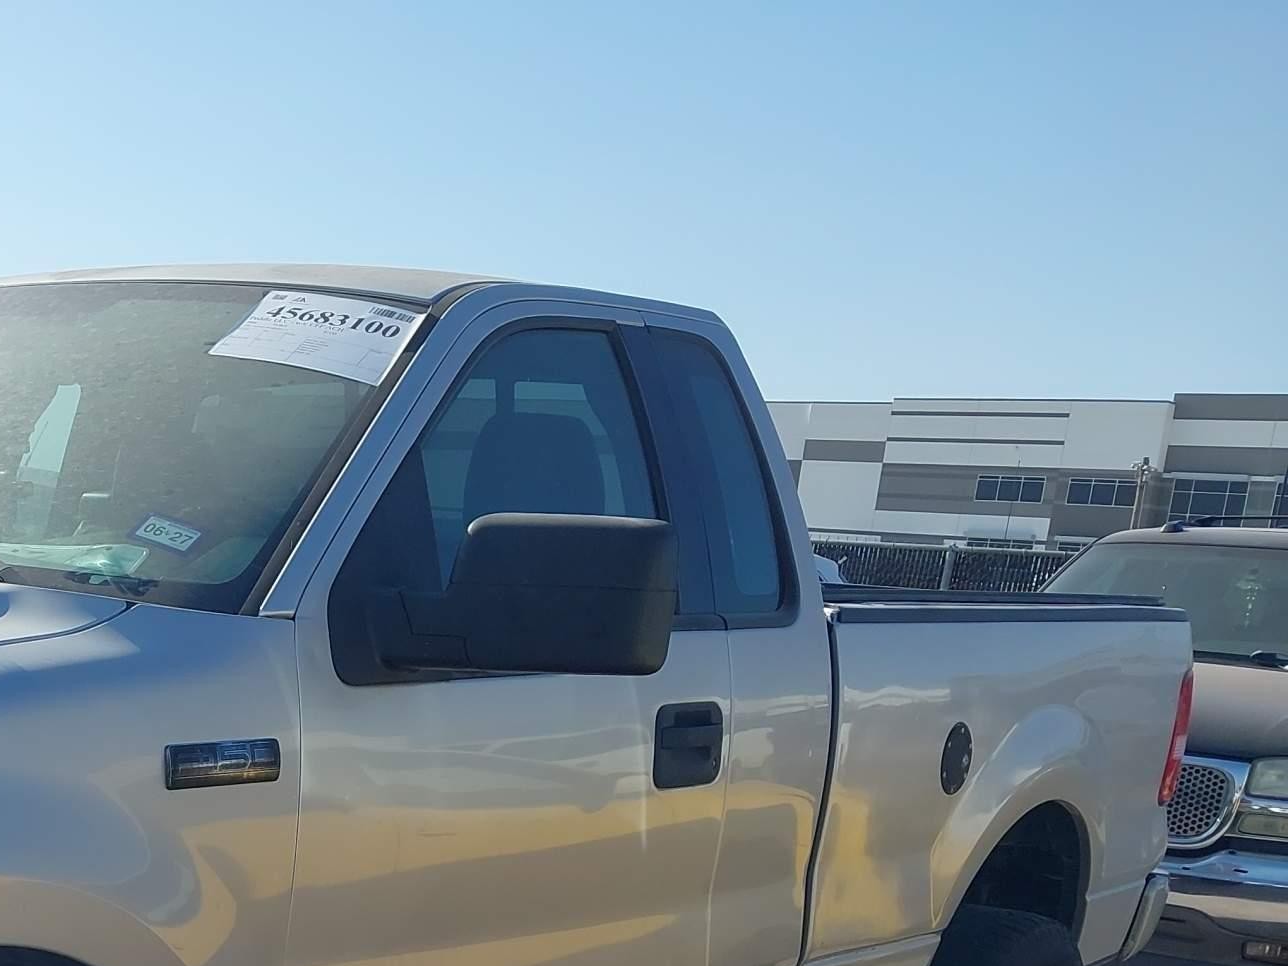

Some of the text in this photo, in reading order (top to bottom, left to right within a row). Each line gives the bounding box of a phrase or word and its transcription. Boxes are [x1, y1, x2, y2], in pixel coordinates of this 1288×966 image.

[266, 305, 401, 338] 45683100
[143, 523, 194, 545] 06 27
